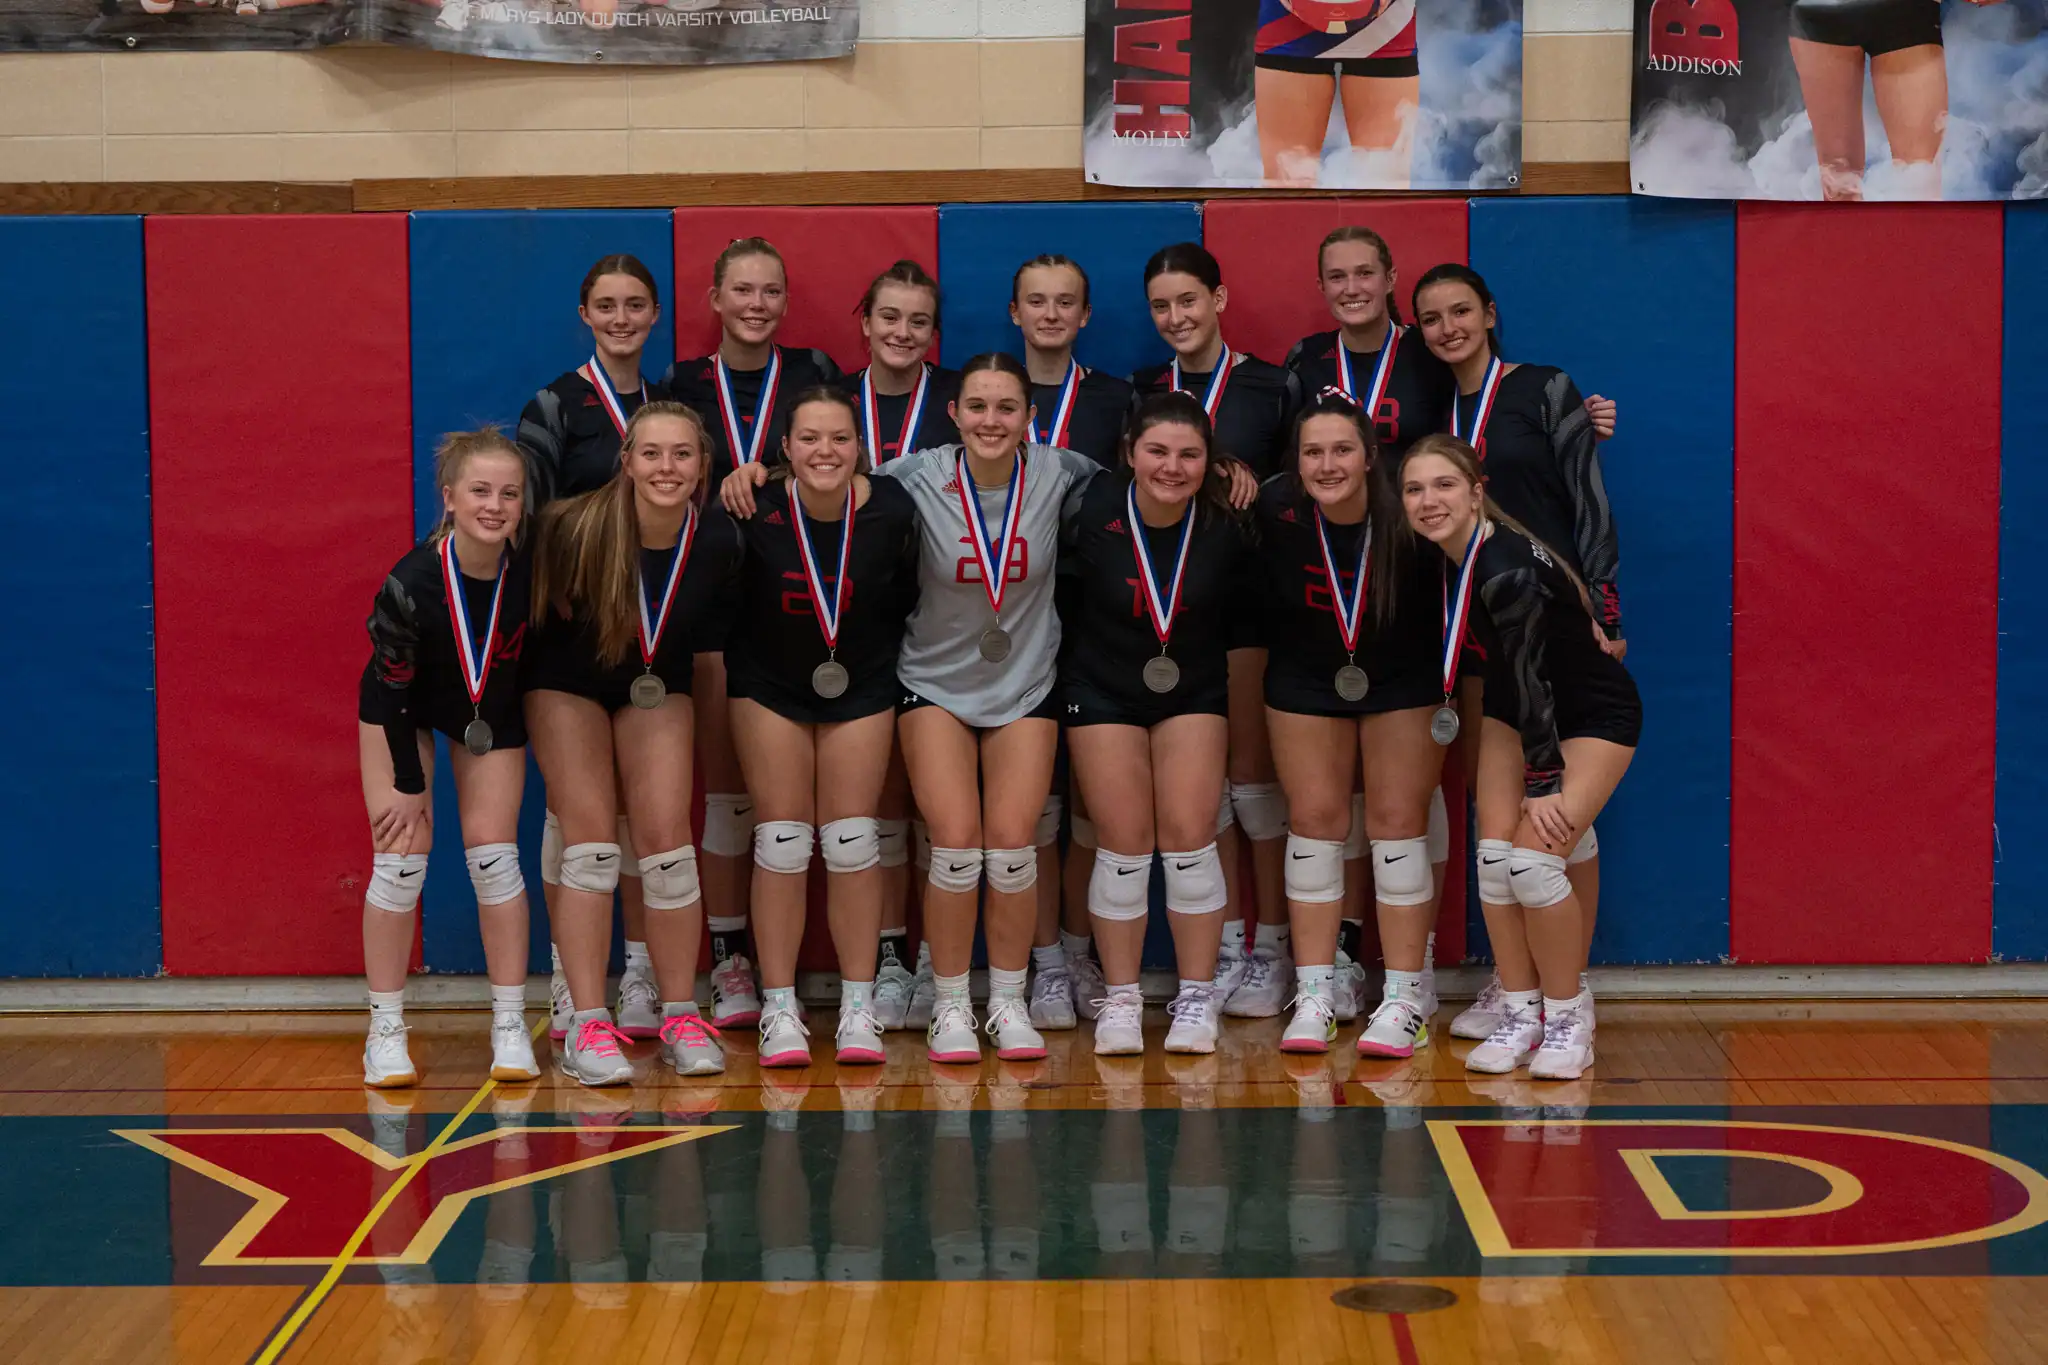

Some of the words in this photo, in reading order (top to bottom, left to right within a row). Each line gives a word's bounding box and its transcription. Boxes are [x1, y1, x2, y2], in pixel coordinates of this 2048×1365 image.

[481, 8, 540, 24] MRYS
[545, 11, 585, 25] LADY
[591, 12, 649, 27] DUTCH
[655, 11, 724, 27] VARSITY
[728, 6, 831, 25] VOLLEYBALL
[1113, 0, 1192, 138] HA
[1646, 53, 1743, 76] ADDISON
[1112, 129, 1192, 147] MOLLY
[1424, 1119, 2048, 1258] D
